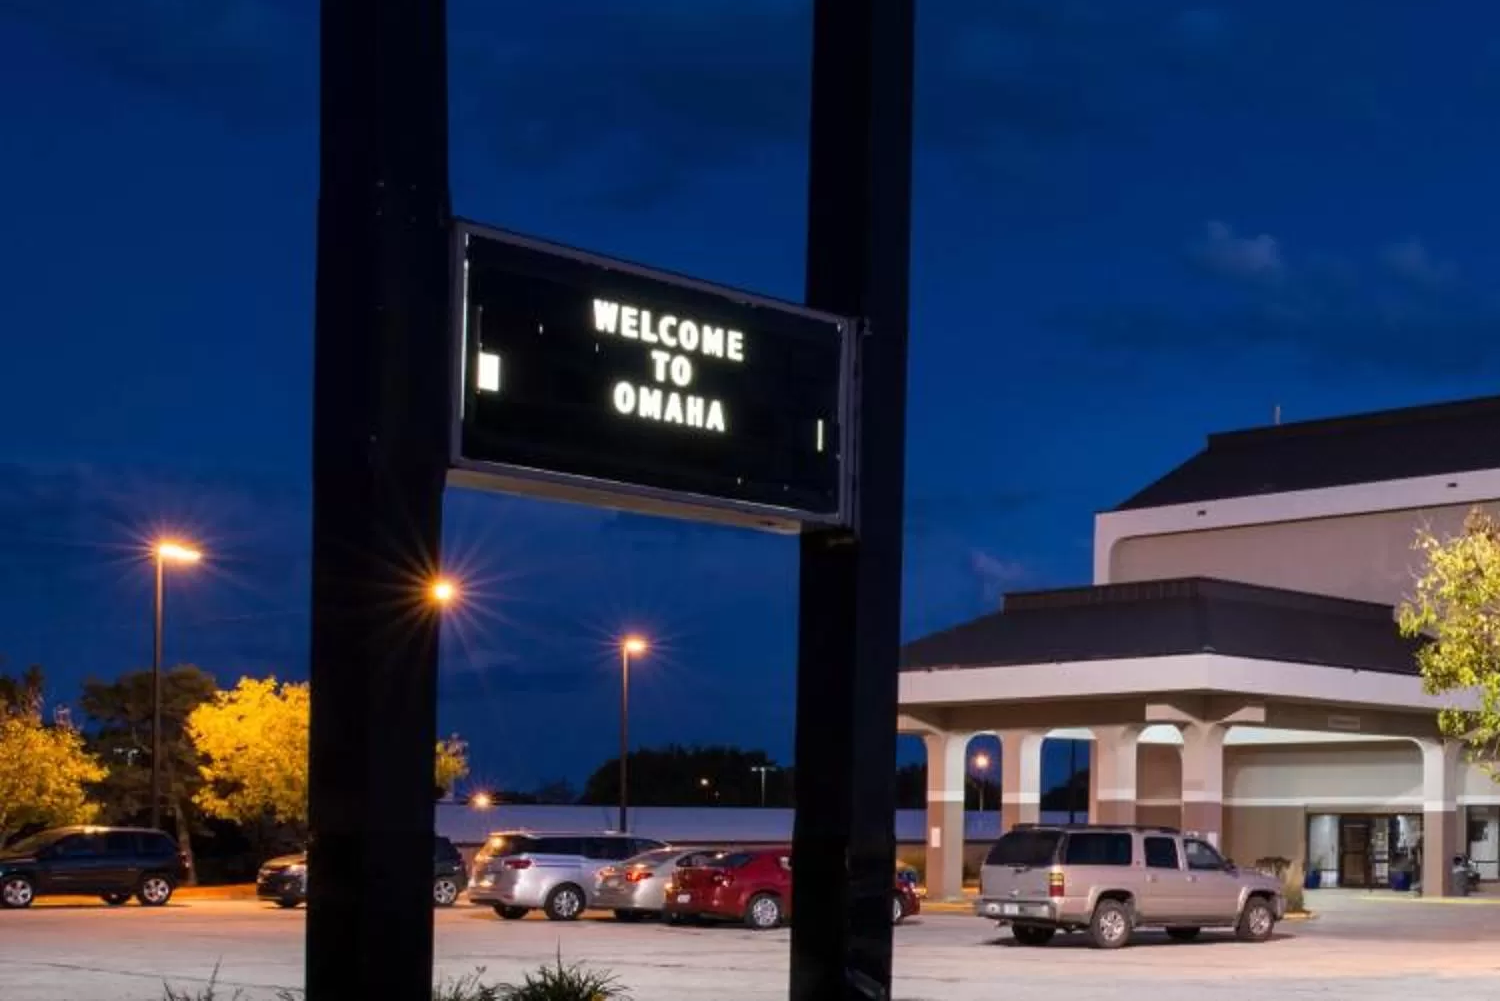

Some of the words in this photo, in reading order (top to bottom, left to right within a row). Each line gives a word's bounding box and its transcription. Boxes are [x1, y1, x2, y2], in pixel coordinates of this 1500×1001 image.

[593, 299, 744, 361] WELCOME
[650, 350, 692, 387] TO
[613, 382, 725, 432] OMAHA
